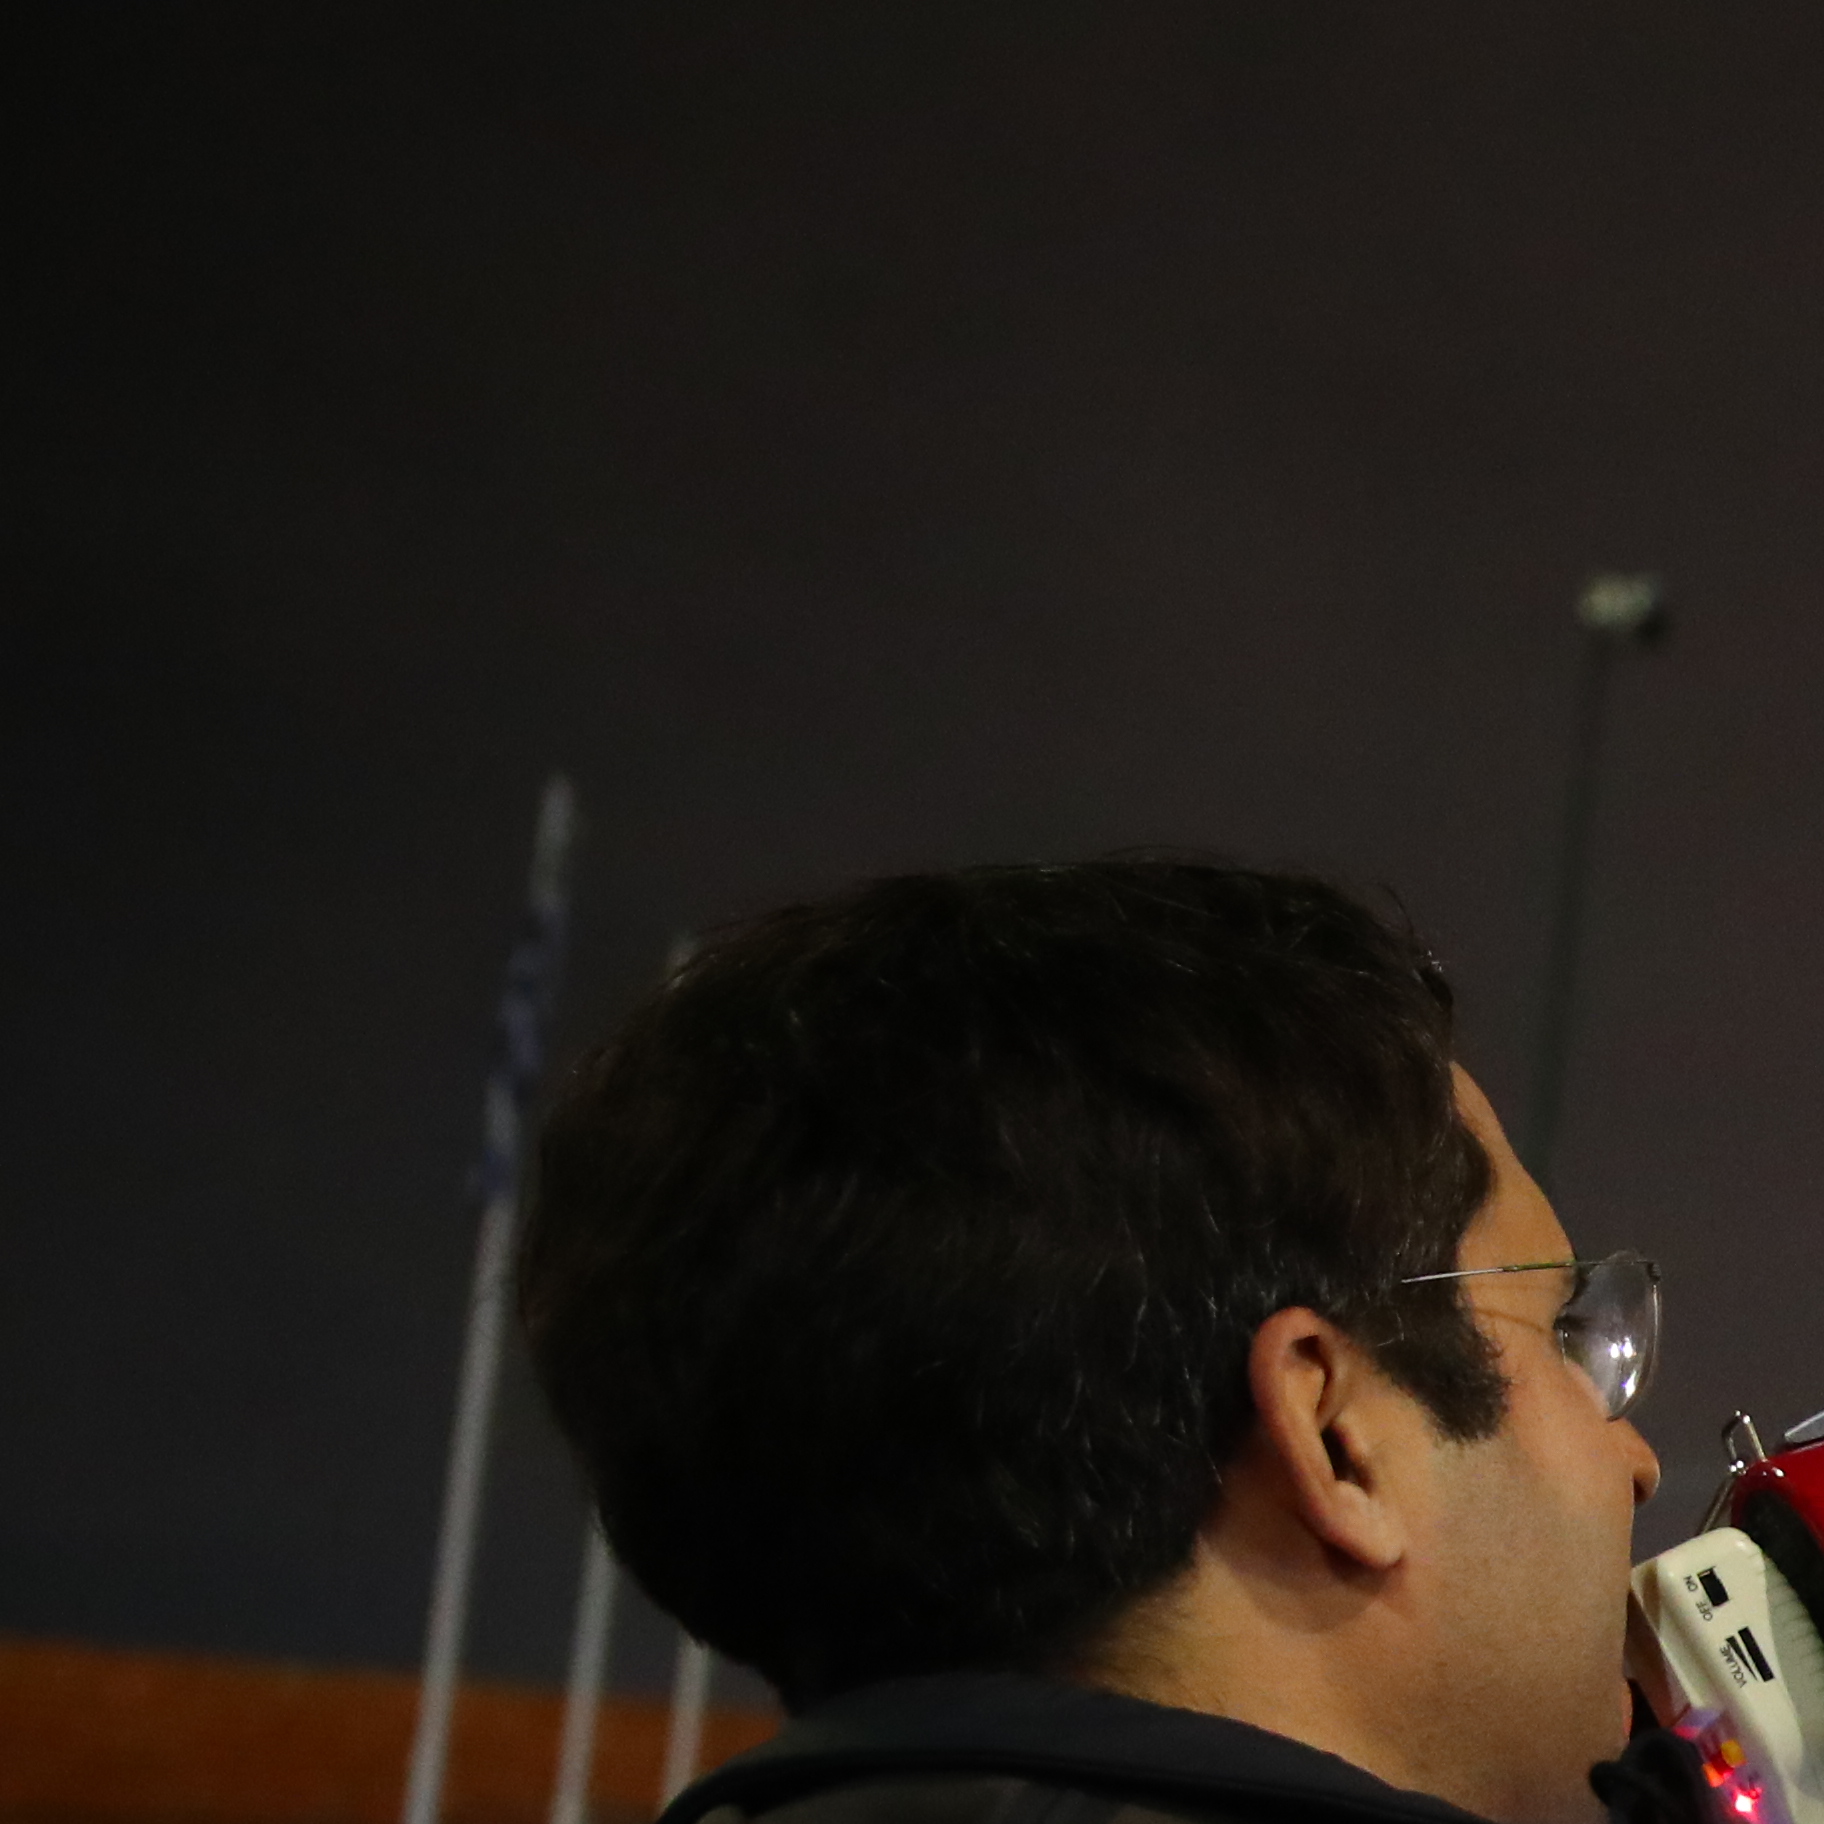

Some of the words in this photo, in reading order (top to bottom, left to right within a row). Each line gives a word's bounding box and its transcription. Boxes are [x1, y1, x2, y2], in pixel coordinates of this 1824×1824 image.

[1684, 1575, 1698, 1592] ON
[1696, 1601, 1713, 1621] OFF
[1720, 1644, 1747, 1689] VOLUME
